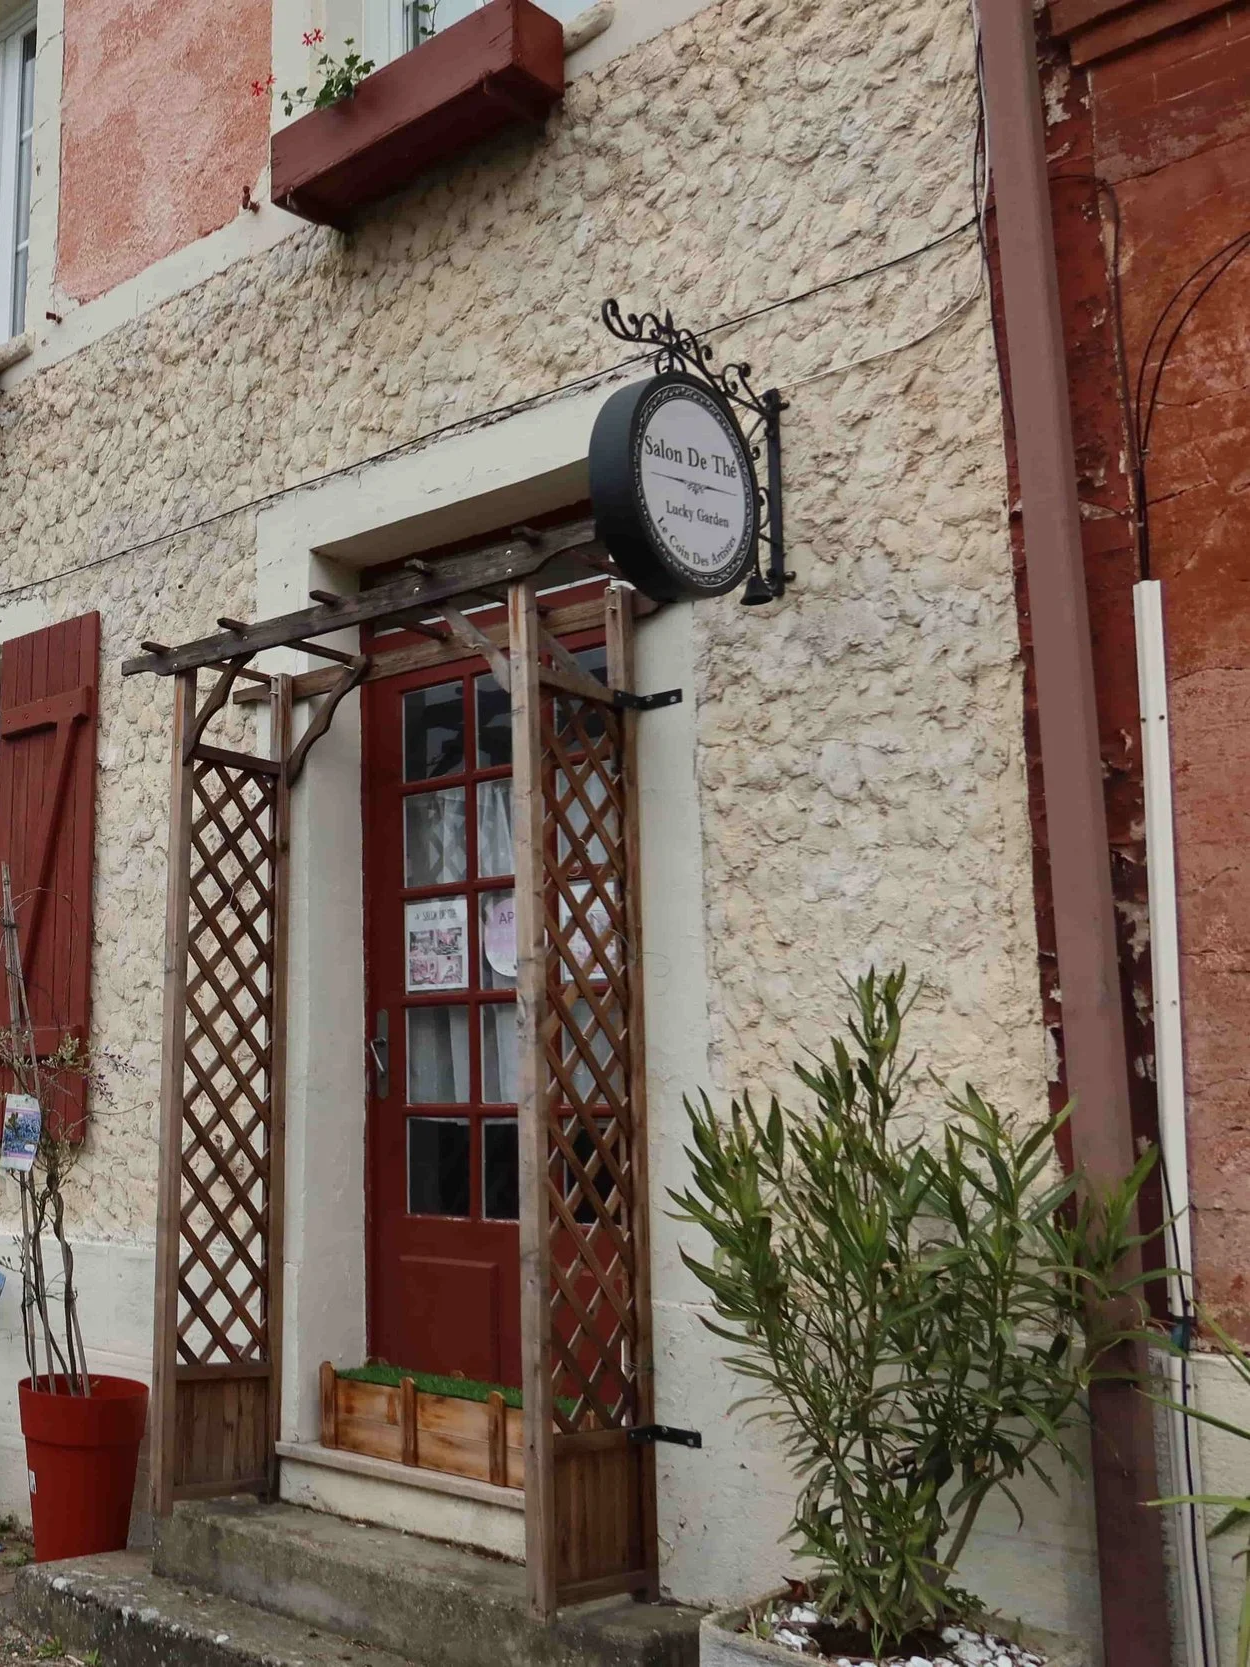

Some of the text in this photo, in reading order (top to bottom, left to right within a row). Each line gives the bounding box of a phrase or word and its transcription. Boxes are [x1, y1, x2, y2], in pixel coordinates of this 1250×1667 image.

[644, 434, 737, 478] Salon De Thé
[665, 500, 729, 528] Lucky Garden
[657, 516, 737, 567] Le Coin Des Artistes
